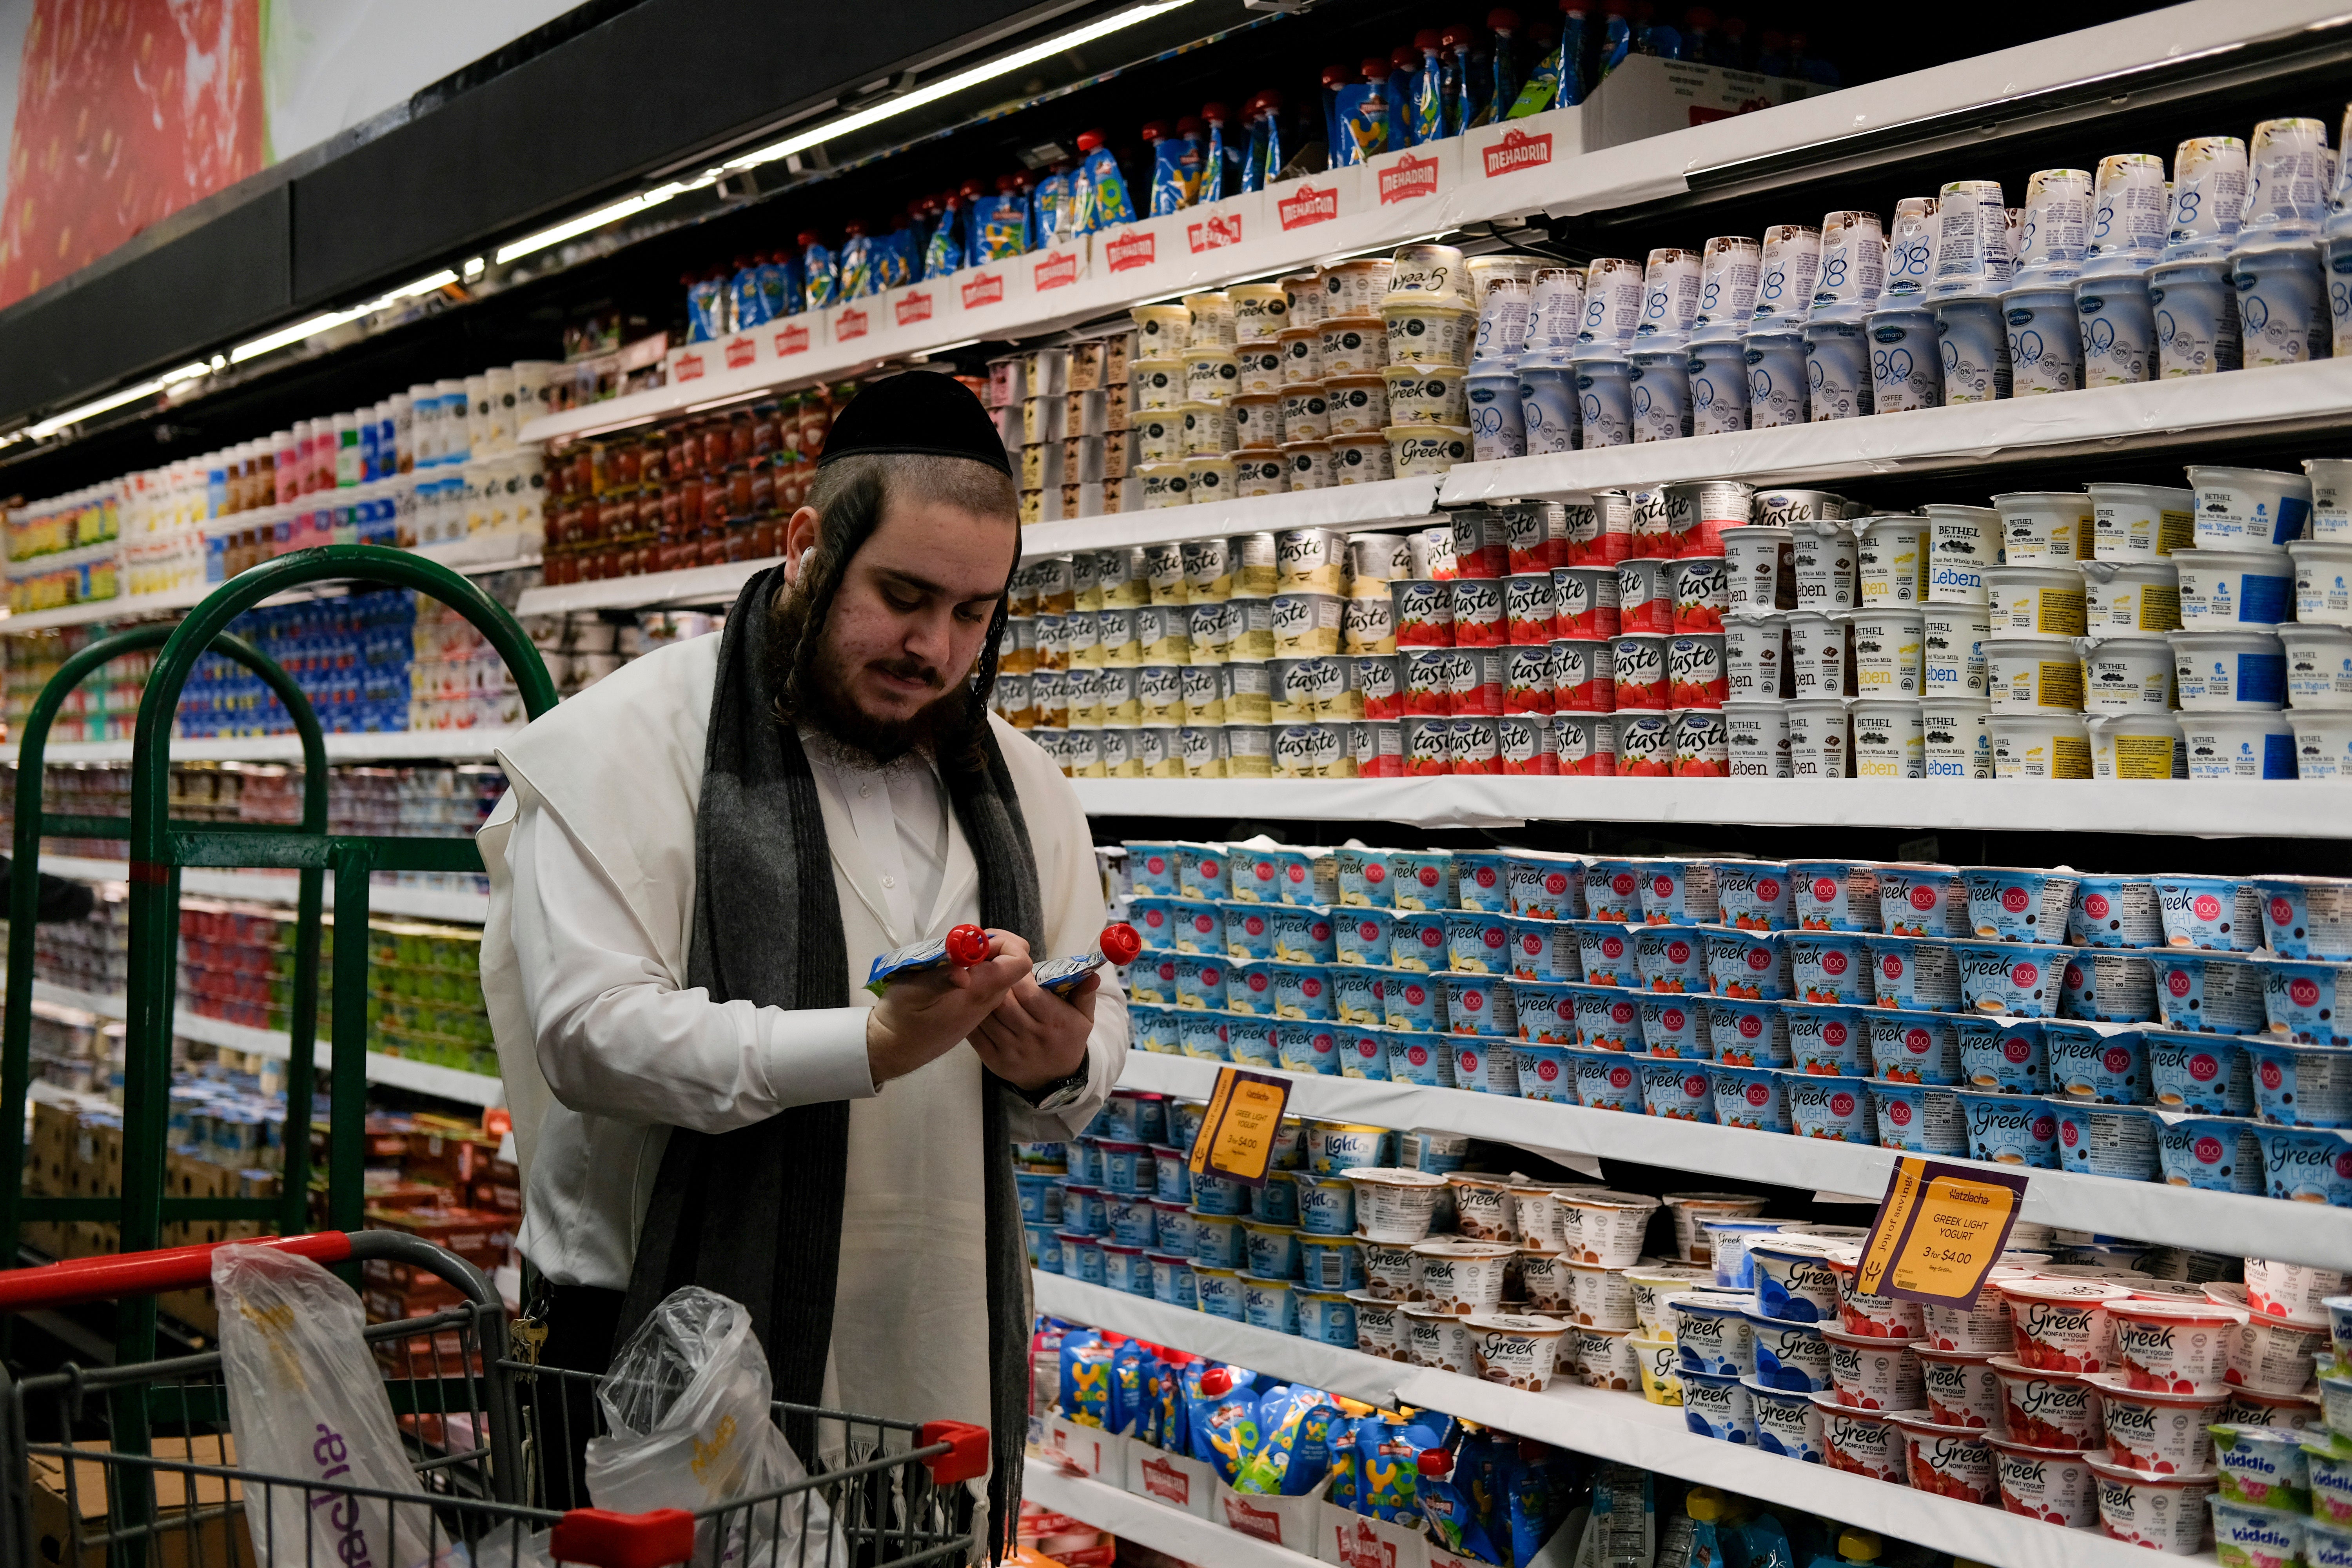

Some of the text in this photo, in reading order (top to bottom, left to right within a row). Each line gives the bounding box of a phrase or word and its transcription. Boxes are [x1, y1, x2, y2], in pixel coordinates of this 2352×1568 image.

[1488, 142, 1548, 172] MEHADRIN
[1382, 166, 1434, 194] MEHADRIN
[1874, 348, 1913, 380] 80
[1389, 380, 1424, 407] Greek
[1401, 439, 1448, 465] Greek
[2205, 493, 2232, 501] BETHEL
[1761, 501, 1811, 526] taste
[1939, 526, 1980, 537] BETHEL
[2216, 523, 2242, 532] Yogurt
[1932, 568, 1981, 588] Leben
[1454, 589, 1498, 615] taste
[1507, 586, 1553, 613] taste
[1614, 648, 1659, 675] taste
[1670, 645, 1716, 675] taste
[2113, 690, 2139, 699] Yogurt
[1729, 721, 1761, 730] BETHEL
[1858, 719, 1892, 728] BETHEL
[1925, 718, 1957, 726] BETHEL
[1730, 761, 1768, 775] Leben
[1857, 760, 1899, 776] Leben
[1548, 880, 1565, 889] 100
[1715, 867, 1757, 898] Greek
[1817, 886, 1833, 894] 100
[1518, 886, 1544, 897] LIGHT
[1727, 893, 1755, 904] LIGHT
[2006, 895, 2026, 905] 100
[2197, 903, 2217, 913] 100
[1975, 978, 2010, 990] LIGHT
[2051, 1031, 2105, 1065] Greek
[1235, 1109, 1268, 1122] GREEK LIGHT
[1974, 1102, 2034, 1136] Greek
[1237, 1120, 1258, 1130] YOGURT
[1227, 1134, 1232, 1143] 3
[1993, 1131, 2030, 1144] LIGHT
[1325, 1135, 1359, 1159] Light
[2270, 1136, 2337, 1172] Greek
[1458, 1184, 1505, 1210] Greek
[1949, 1189, 1990, 1205] Hatzlacha
[1878, 1174, 1913, 1252] joy of savings
[1933, 1214, 1989, 1230] GREEK LIGHT
[1940, 1228, 1973, 1241] YOGURT
[1923, 1247, 1931, 1257] 3
[1941, 1249, 1971, 1264] $4.00
[2027, 1302, 2096, 1336] Greek
[1483, 1332, 1540, 1359] Greek
[1683, 1376, 1733, 1405] Greek
[1998, 1451, 2047, 1483] Greek
[2223, 1452, 2275, 1474] kiddie
[2018, 1493, 2043, 1501] strawberry
[2232, 1527, 2290, 1548] kiddie
